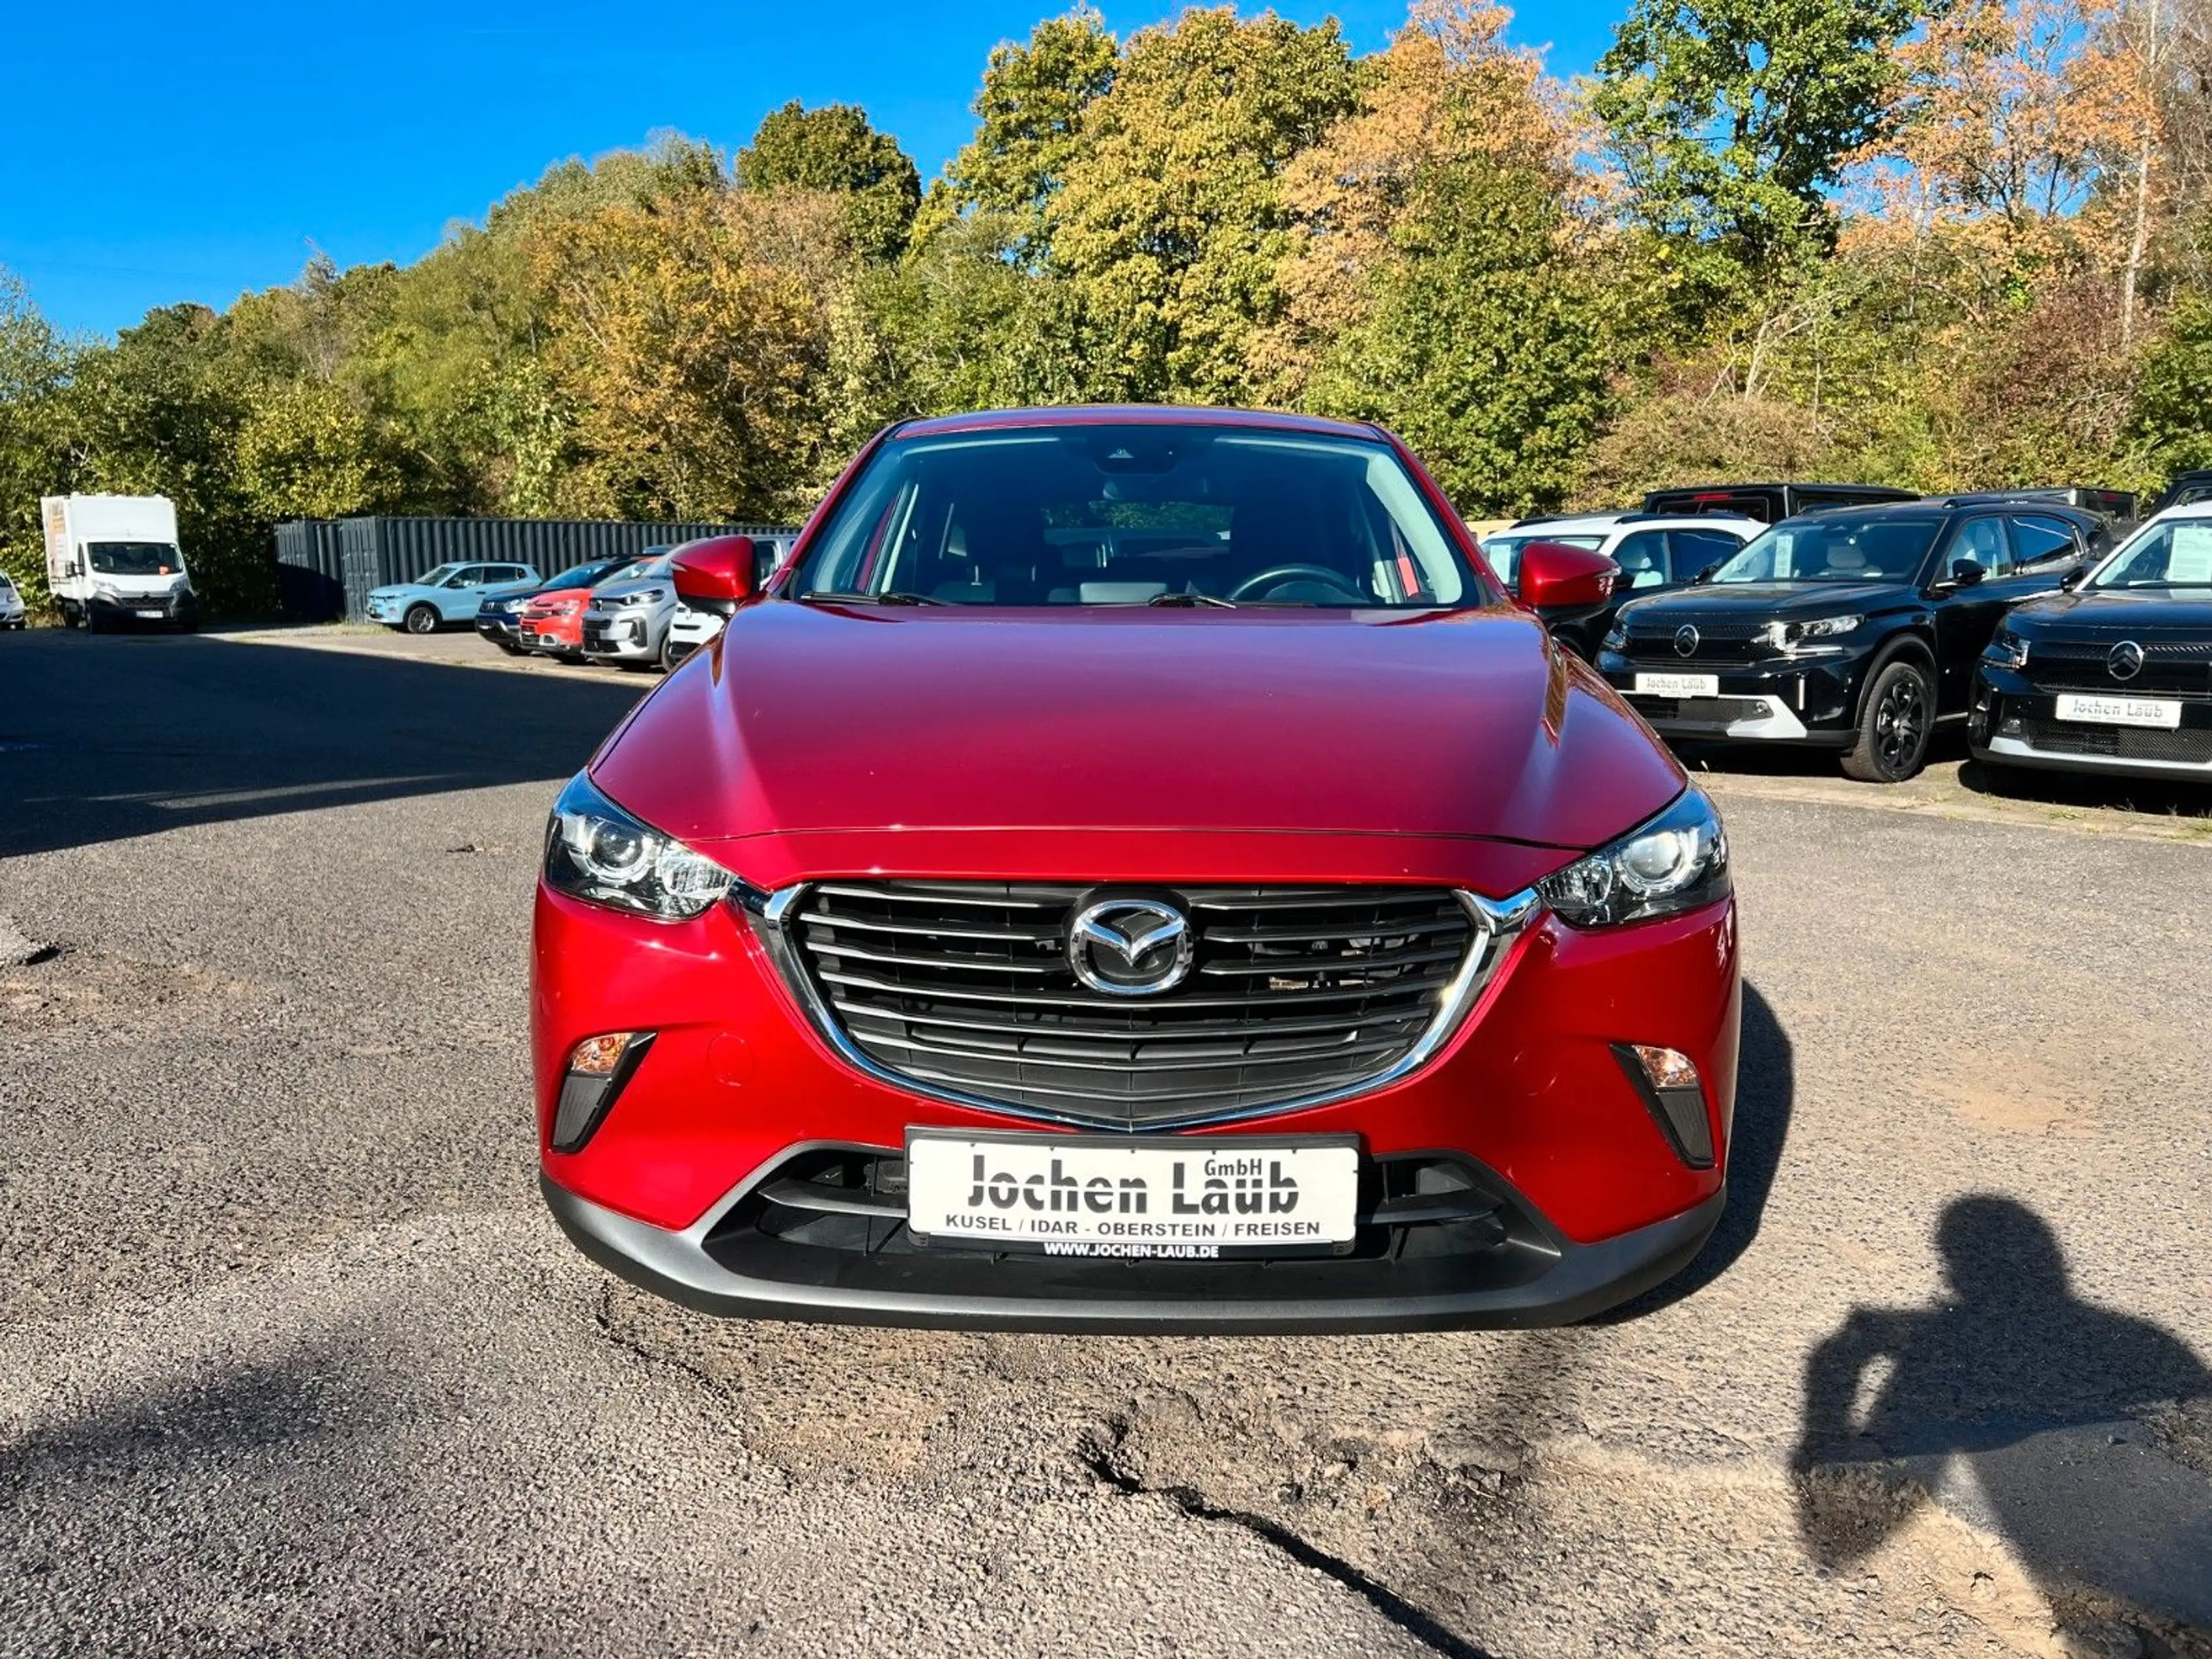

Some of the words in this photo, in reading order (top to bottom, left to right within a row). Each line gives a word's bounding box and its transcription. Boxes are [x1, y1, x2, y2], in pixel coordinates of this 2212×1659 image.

[1204, 1158, 1262, 1176] GmbH
[968, 1154, 1147, 1214] Jochen
[1172, 1161, 1299, 1215] Laub
[945, 1214, 1012, 1231] KUSEL
[1031, 1219, 1078, 1234] IDAR
[1097, 1222, 1215, 1237] OBERSTEIN
[1234, 1221, 1320, 1237] FREISEN
[1043, 1241, 1219, 1259] WWW.JOCHEN-LAUB.DE
